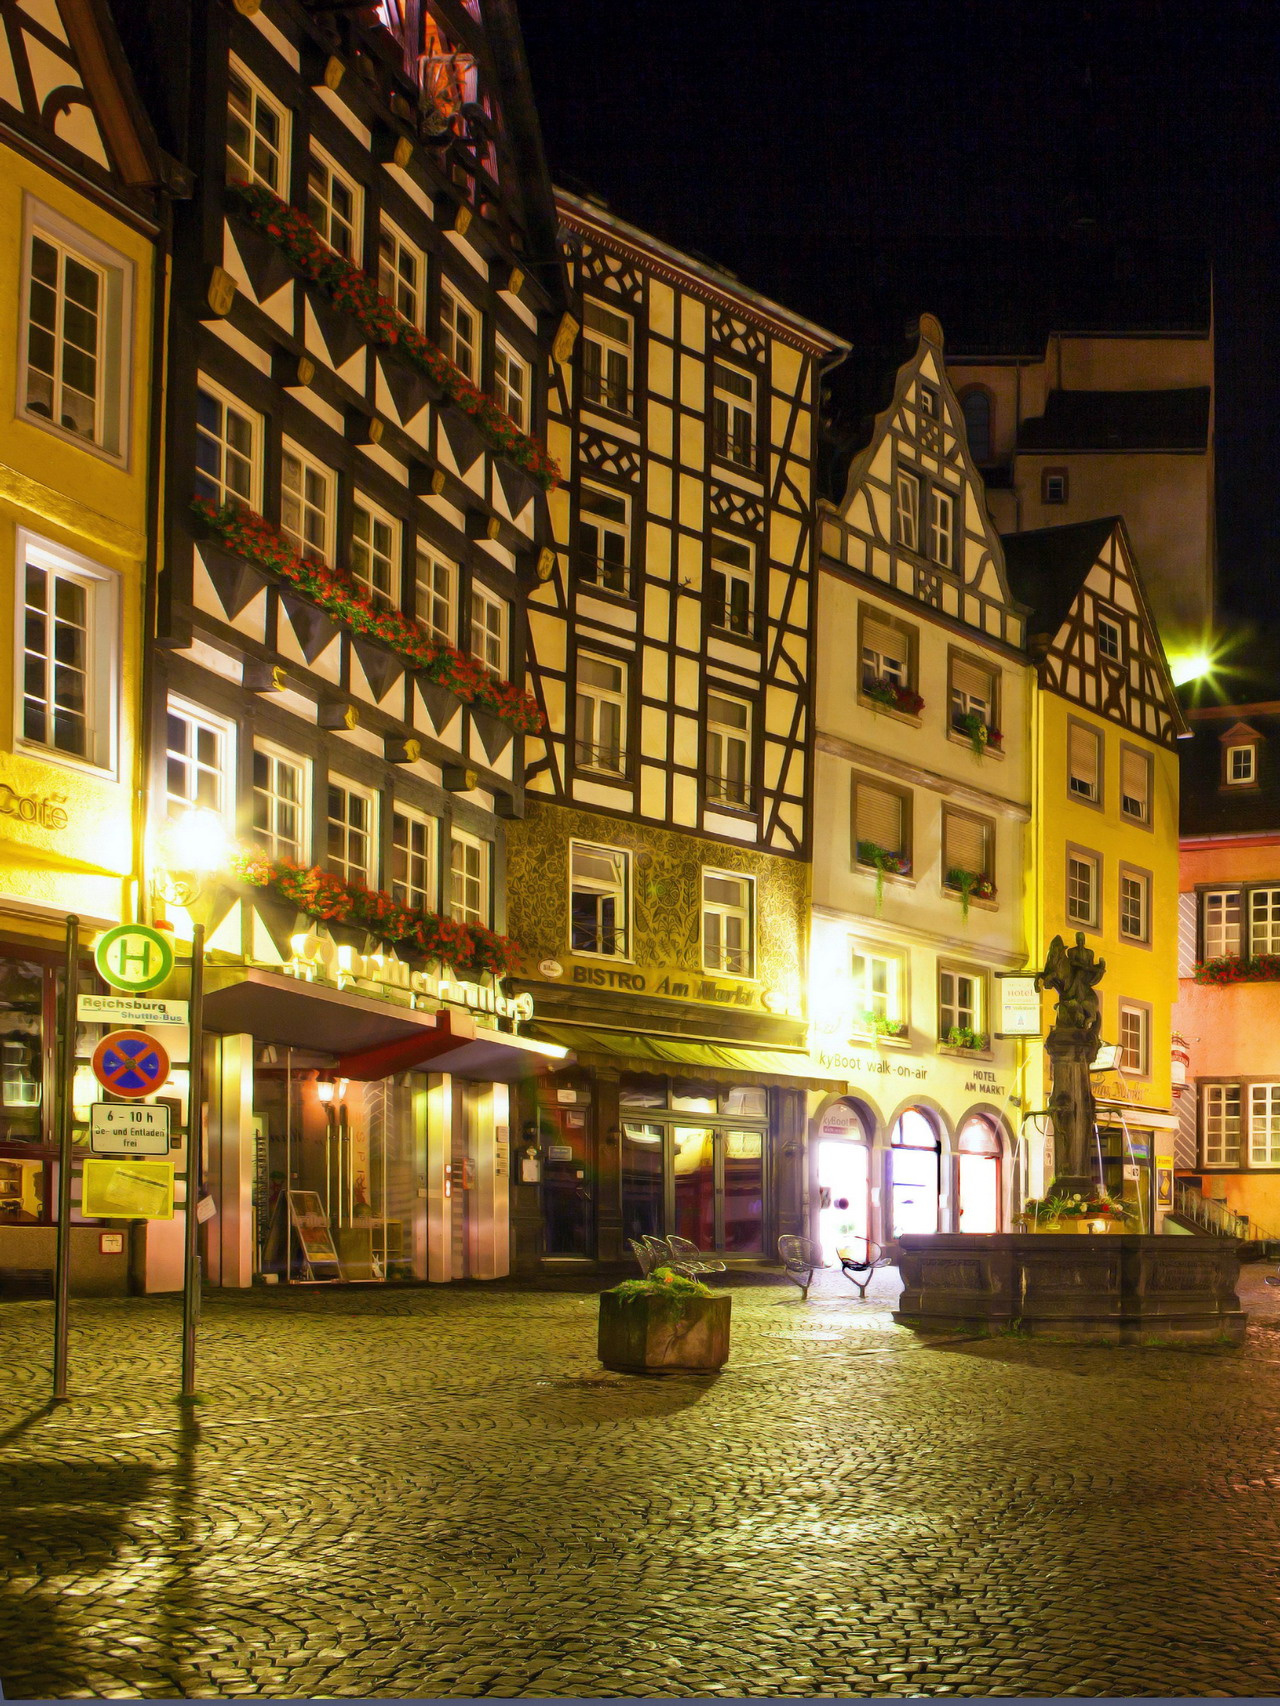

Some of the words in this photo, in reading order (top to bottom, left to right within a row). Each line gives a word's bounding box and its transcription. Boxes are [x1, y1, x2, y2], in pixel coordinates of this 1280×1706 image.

[119, 938, 151, 977] H
[573, 965, 646, 992] BISTRO
[656, 976, 689, 998] Am
[82, 997, 167, 1013] Reichsburg
[121, 1011, 183, 1021] Shuttle-Bus
[819, 1051, 861, 1070] kyBoot
[867, 1060, 928, 1080] walk-on-air
[972, 1070, 996, 1083] HOTEL
[964, 1082, 978, 1093] AM
[979, 1083, 1006, 1095] MARKT
[107, 1110, 114, 1122] 6
[130, 1111, 143, 1123] 10
[146, 1113, 153, 1124] h
[112, 1127, 128, 1136] und
[130, 1127, 165, 1138] Entladen
[122, 1138, 138, 1147] frei
